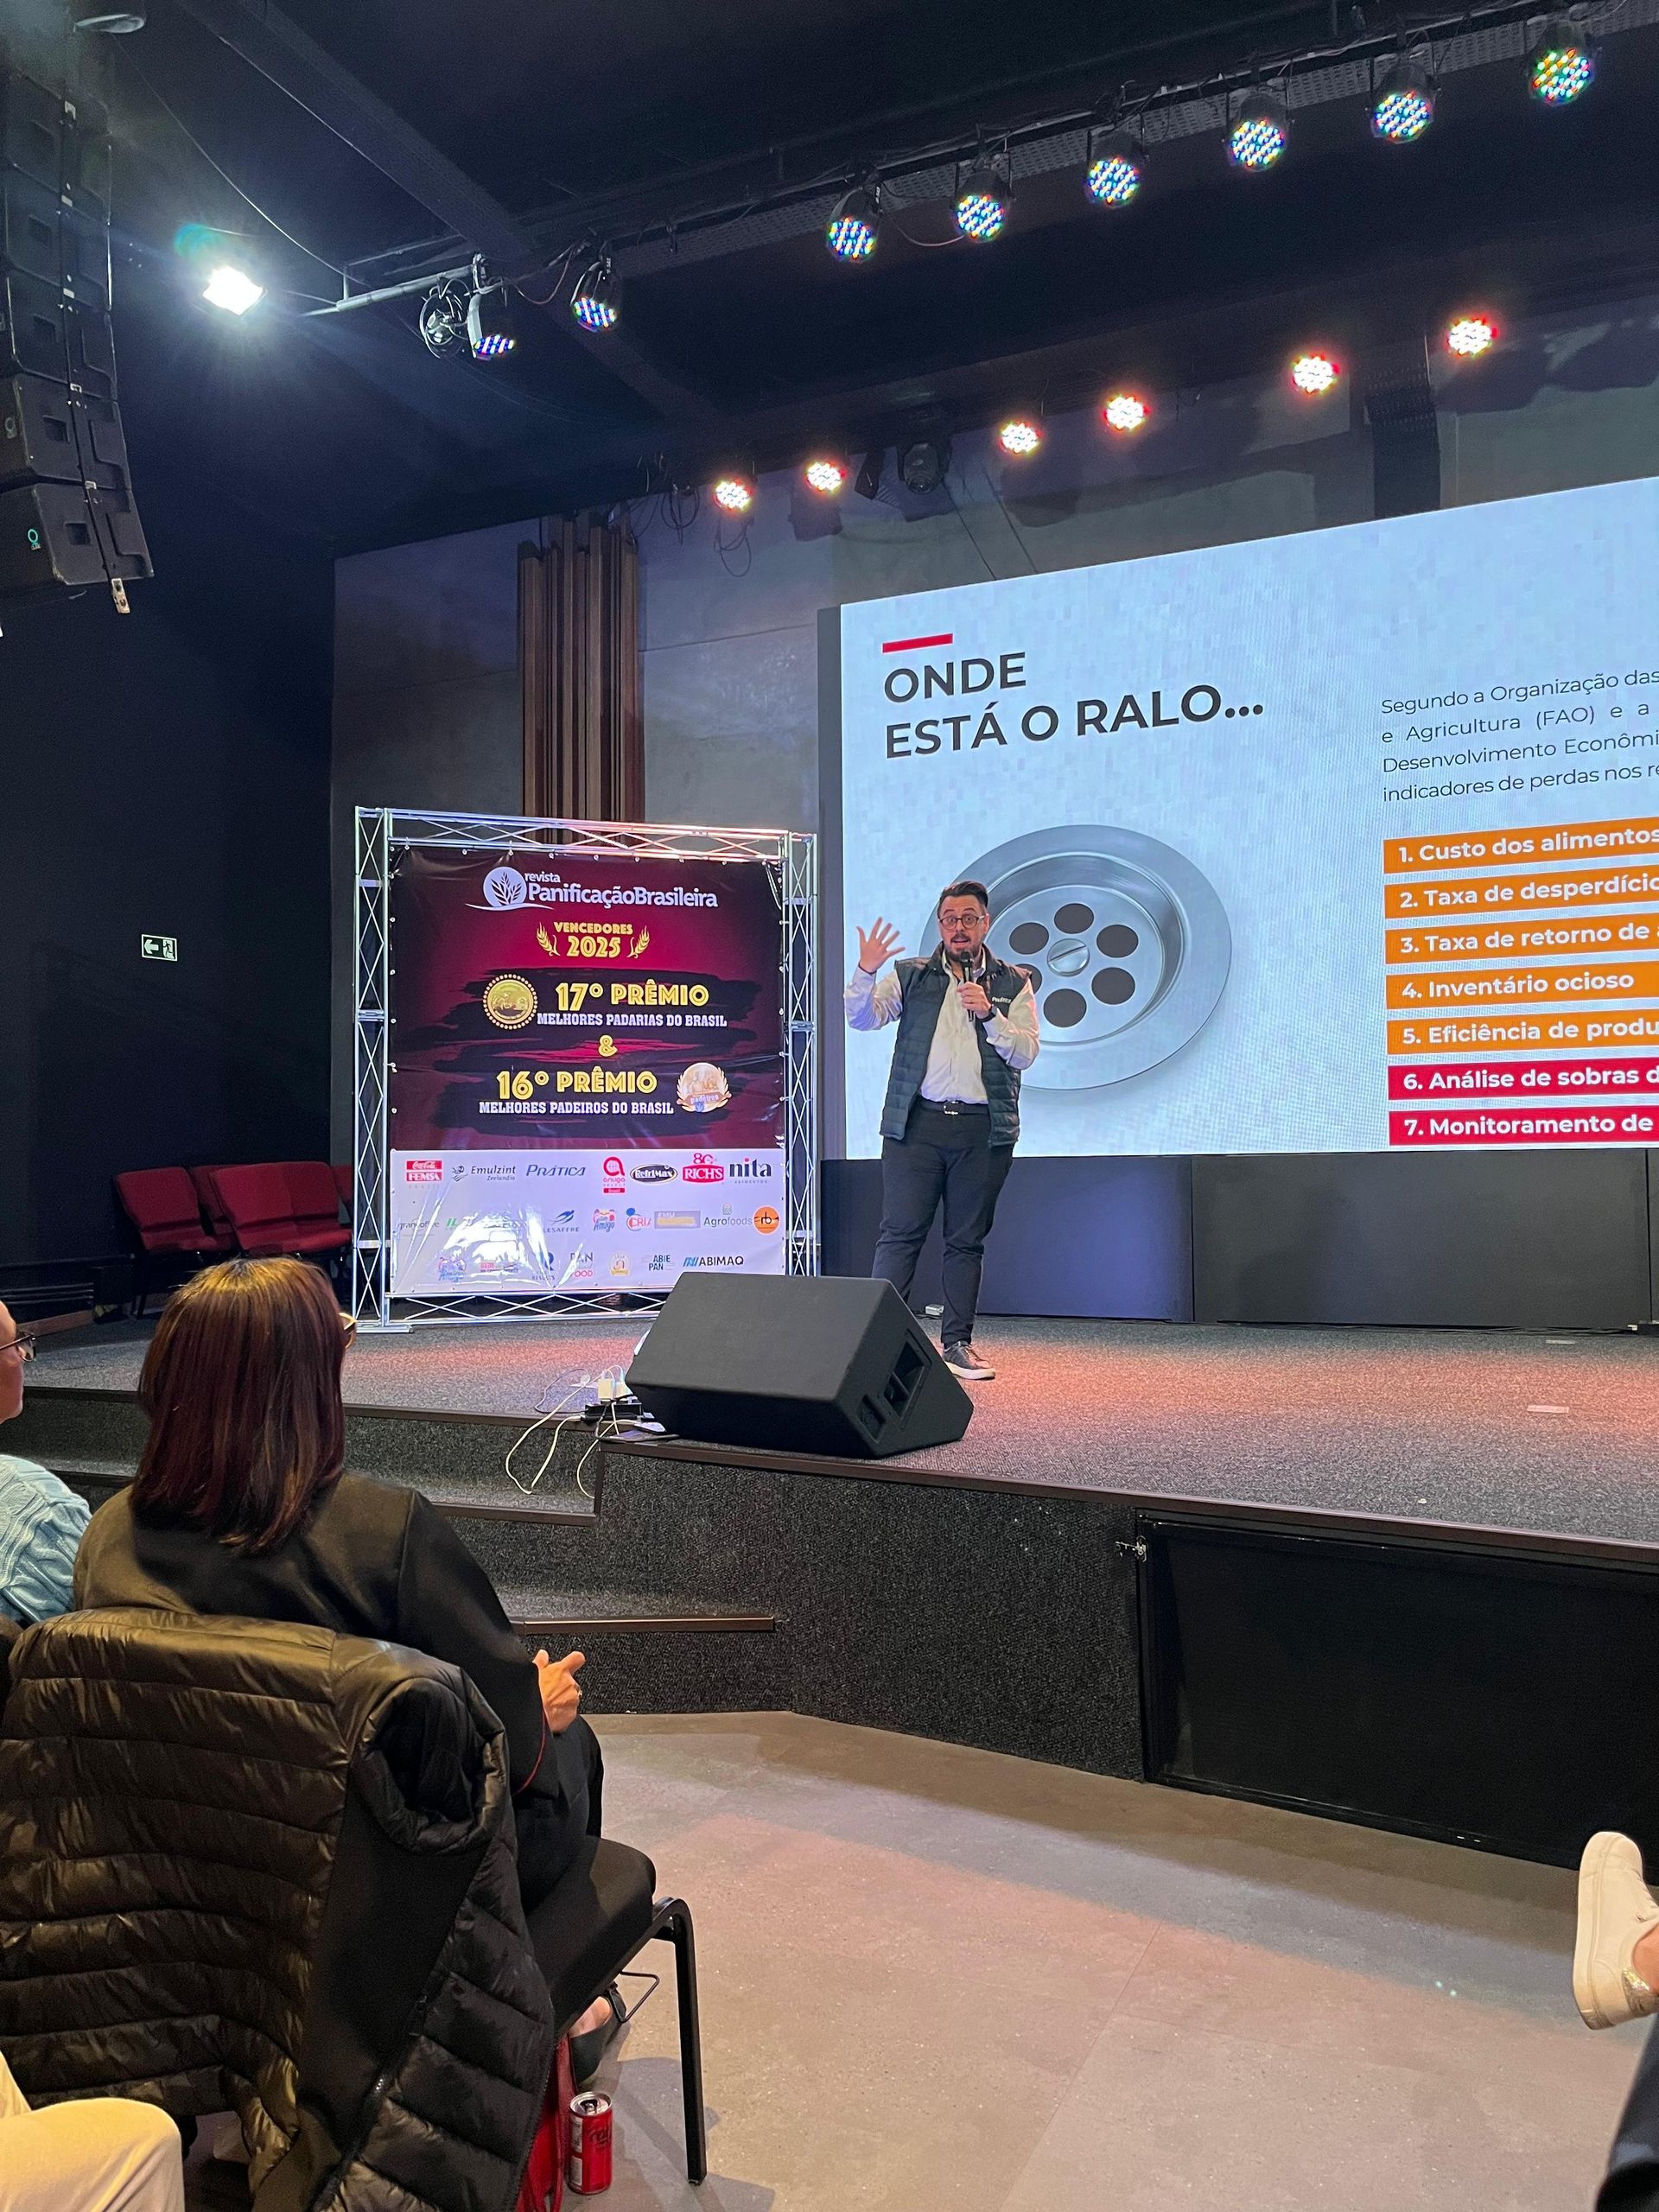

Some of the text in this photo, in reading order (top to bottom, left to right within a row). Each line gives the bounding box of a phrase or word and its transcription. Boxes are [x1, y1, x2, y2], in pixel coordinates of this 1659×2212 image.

[885, 652, 1027, 703] ONDE
[1382, 670, 1659, 715] Segundo a Organização das
[887, 684, 1263, 759] ESTÁ O RALO...
[1382, 703, 1649, 743] e Agricultura (FAO) e a
[1383, 743, 1556, 772] Desenvolvimento
[1383, 781, 1493, 802] indicadores
[1499, 776, 1524, 791] de
[1531, 769, 1599, 791] perdas
[1605, 764, 1642, 781] nos
[1399, 828, 1659, 862] 1. Custo dos alimentos
[524, 871, 561, 883] revista
[529, 883, 718, 908] PanificaçãoBrasileira
[1400, 892, 1418, 908] 2.
[1424, 889, 1478, 906] Taxa
[1484, 885, 1513, 902] de
[554, 921, 632, 935] VENCEDORES
[1401, 937, 1420, 953] 3.
[1425, 935, 1478, 951] Taxa
[1485, 931, 1514, 949] de
[1522, 926, 1611, 946] retorno
[1618, 923, 1649, 940] de
[567, 936, 620, 957] 2025
[611, 978, 709, 1006] PRÊMIO
[1402, 972, 1634, 998] 4. Inventário ocioso
[537, 1013, 603, 1027] MELHORES
[607, 1014, 663, 1027] PADARIAS
[666, 1014, 683, 1027] DO
[685, 1014, 727, 1027] BRASIL
[1403, 1018, 1659, 1044] 5. Eficiência de produ
[598, 1035, 617, 1057] &
[556, 1065, 657, 1093] PRÊMIO
[1404, 1074, 1422, 1090] 6.
[1429, 1071, 1514, 1090] Análise
[1521, 1069, 1551, 1087] de
[1558, 1067, 1638, 1085] sobras
[479, 1102, 674, 1115] MELHORES PADEIROS DO BRASIL
[1404, 1115, 1653, 1135] 7. Monitoramento de
[408, 1172, 441, 1181] FEMSA
[471, 1165, 516, 1174] Emulzint
[525, 1165, 586, 1177] PRÁTICA
[729, 1158, 771, 1177] nita
[703, 1217, 753, 1227] Agrofoods
[699, 1256, 743, 1266] ABIMAQ
